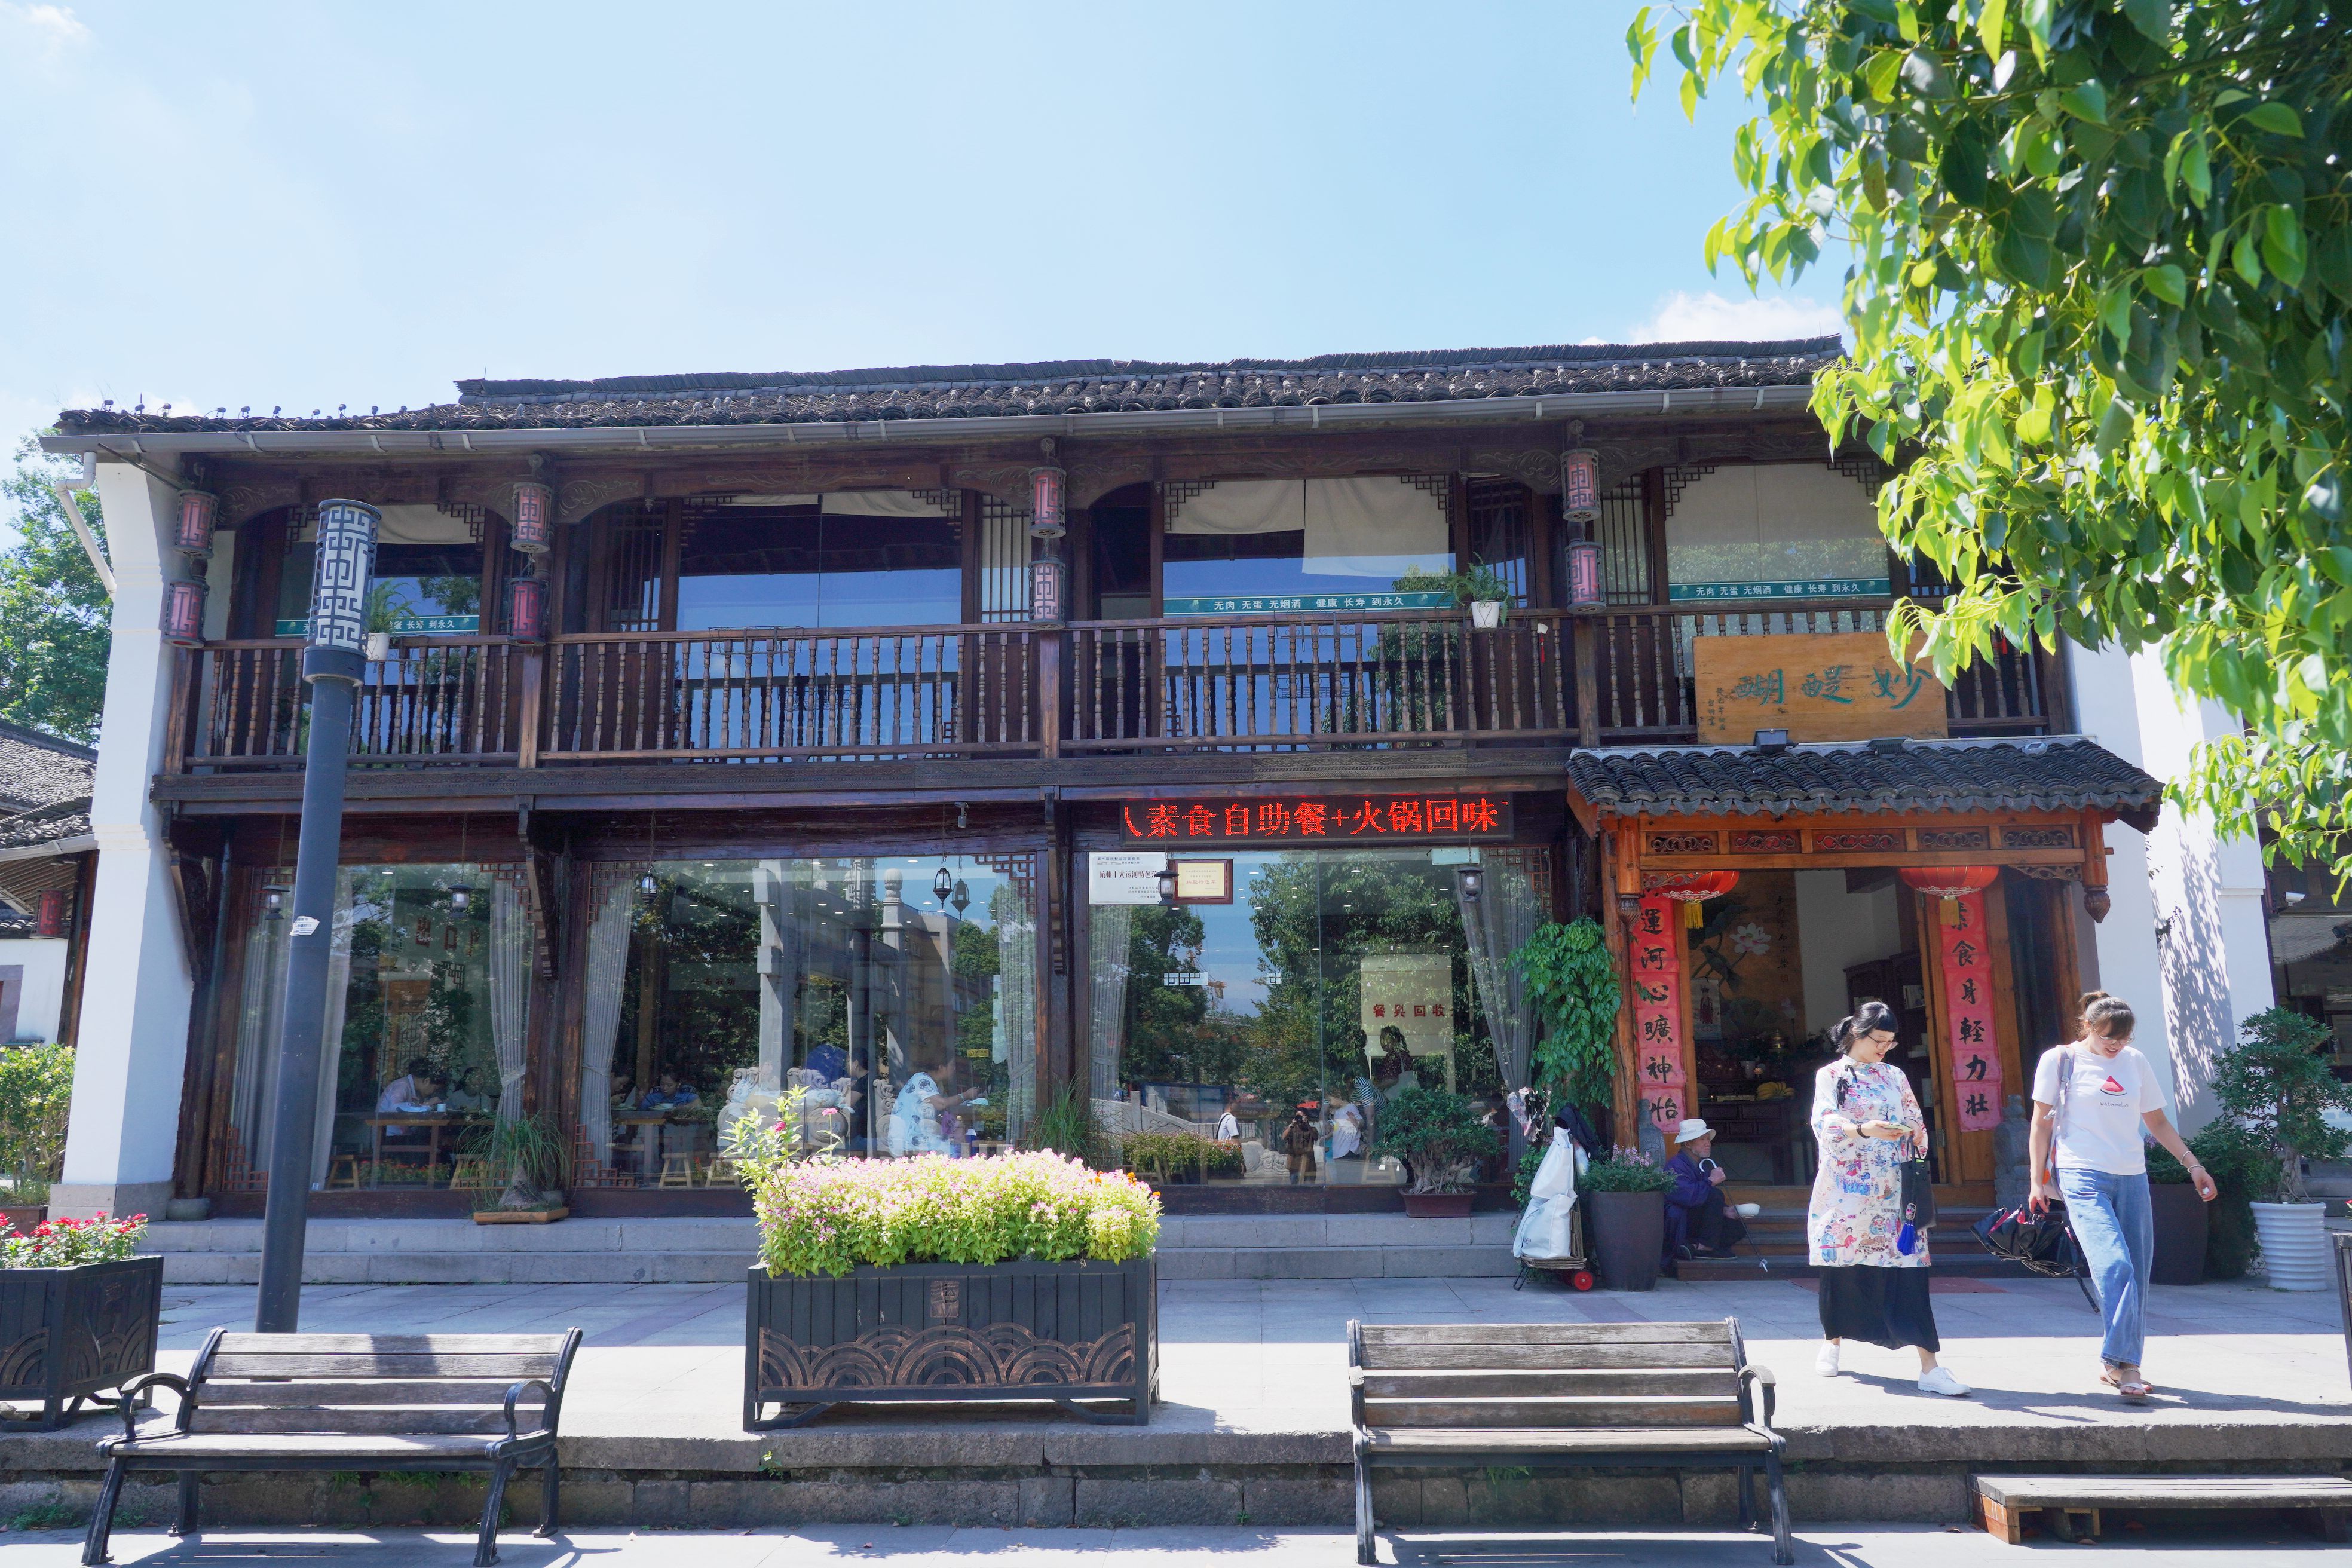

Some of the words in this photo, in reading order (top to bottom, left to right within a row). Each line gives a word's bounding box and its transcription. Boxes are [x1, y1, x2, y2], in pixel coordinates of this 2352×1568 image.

[1696, 587, 1714, 596] 无肉
[1720, 586, 1738, 595] 无蛋
[1744, 586, 1772, 595] 无烟酒
[1784, 584, 1802, 594] 健康
[1808, 584, 1827, 593] 长寿
[1832, 583, 1860, 592] 到永久
[1214, 601, 1235, 610] 无肉
[1242, 600, 1263, 609] 无蛋
[1269, 599, 1301, 608] 无烟酒
[1316, 598, 1337, 608] 健康
[1344, 598, 1365, 607] 长寿
[1371, 597, 1404, 606] 到永久
[406, 620, 424, 629] 长寿
[428, 620, 455, 629] 到永久
[1125, 798, 1508, 837] 素食自助餐+火锅回味
[1373, 1003, 1453, 1018] 餐具回收
[1640, 889, 1678, 1122] 運河心曠神怡
